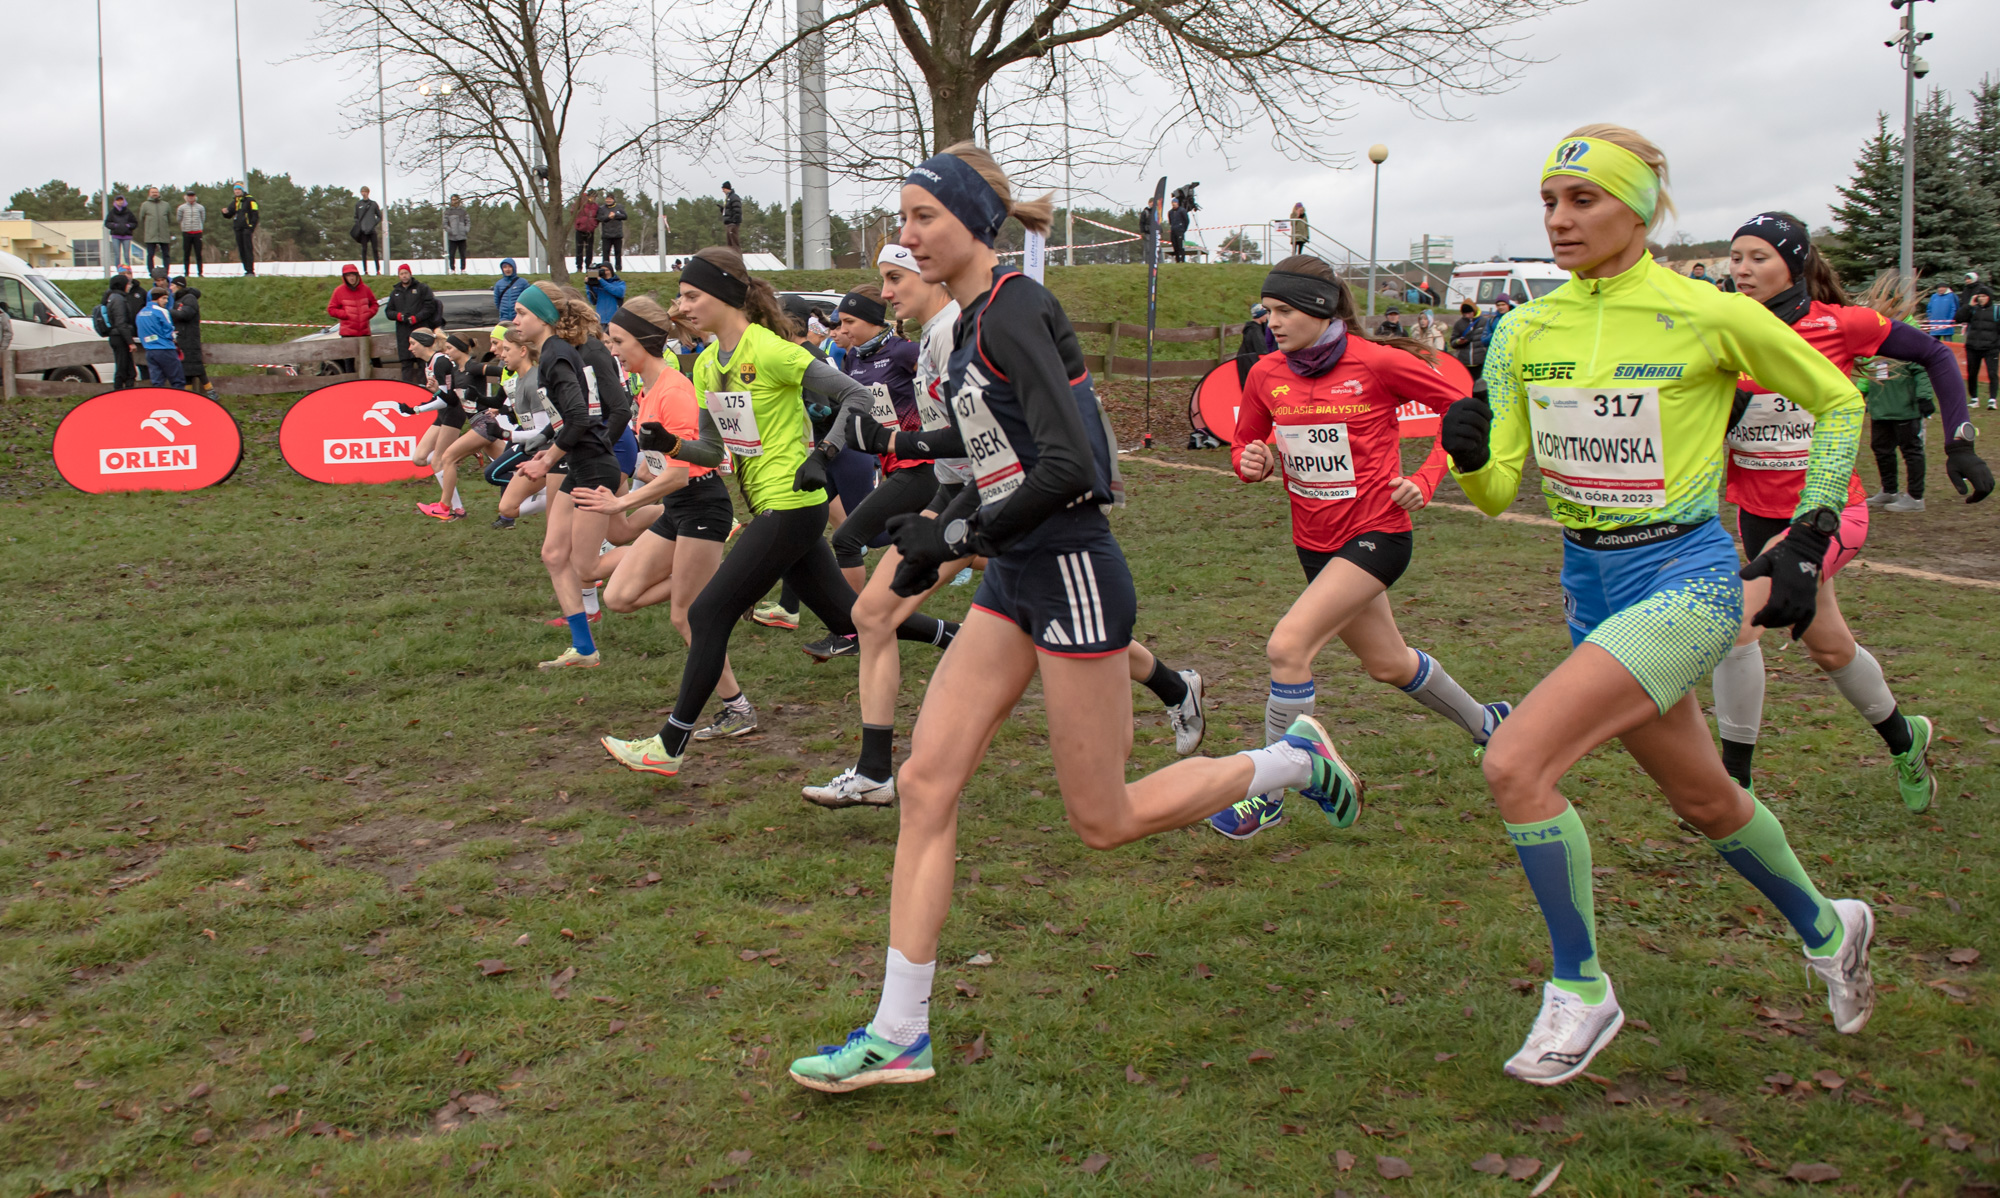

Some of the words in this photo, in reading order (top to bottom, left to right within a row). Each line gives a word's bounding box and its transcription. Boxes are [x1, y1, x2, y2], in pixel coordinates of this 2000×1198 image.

[1613, 363, 1686, 380] SONAROL
[869, 387, 884, 397] 46
[725, 396, 745, 408] 175
[958, 392, 975, 417] 37
[1316, 404, 1372, 414] BIAŁYSTOK
[1396, 401, 1433, 418] ORLE
[1593, 394, 1644, 417] 317
[1773, 398, 1800, 413] 31
[718, 417, 741, 434] BĄK
[1308, 428, 1339, 443] 308
[328, 440, 410, 460] ORLEN
[1537, 431, 1656, 464] KORYTKOWSKA
[105, 448, 190, 470] ORLEN
[1283, 453, 1348, 472] KARPIUK
[1330, 489, 1349, 497] 2023
[1551, 481, 1582, 500] ZIELONA
[1585, 490, 1619, 503] GÓRA
[1621, 493, 1653, 503] 2023
[1595, 524, 1678, 545] AdRunaLine
